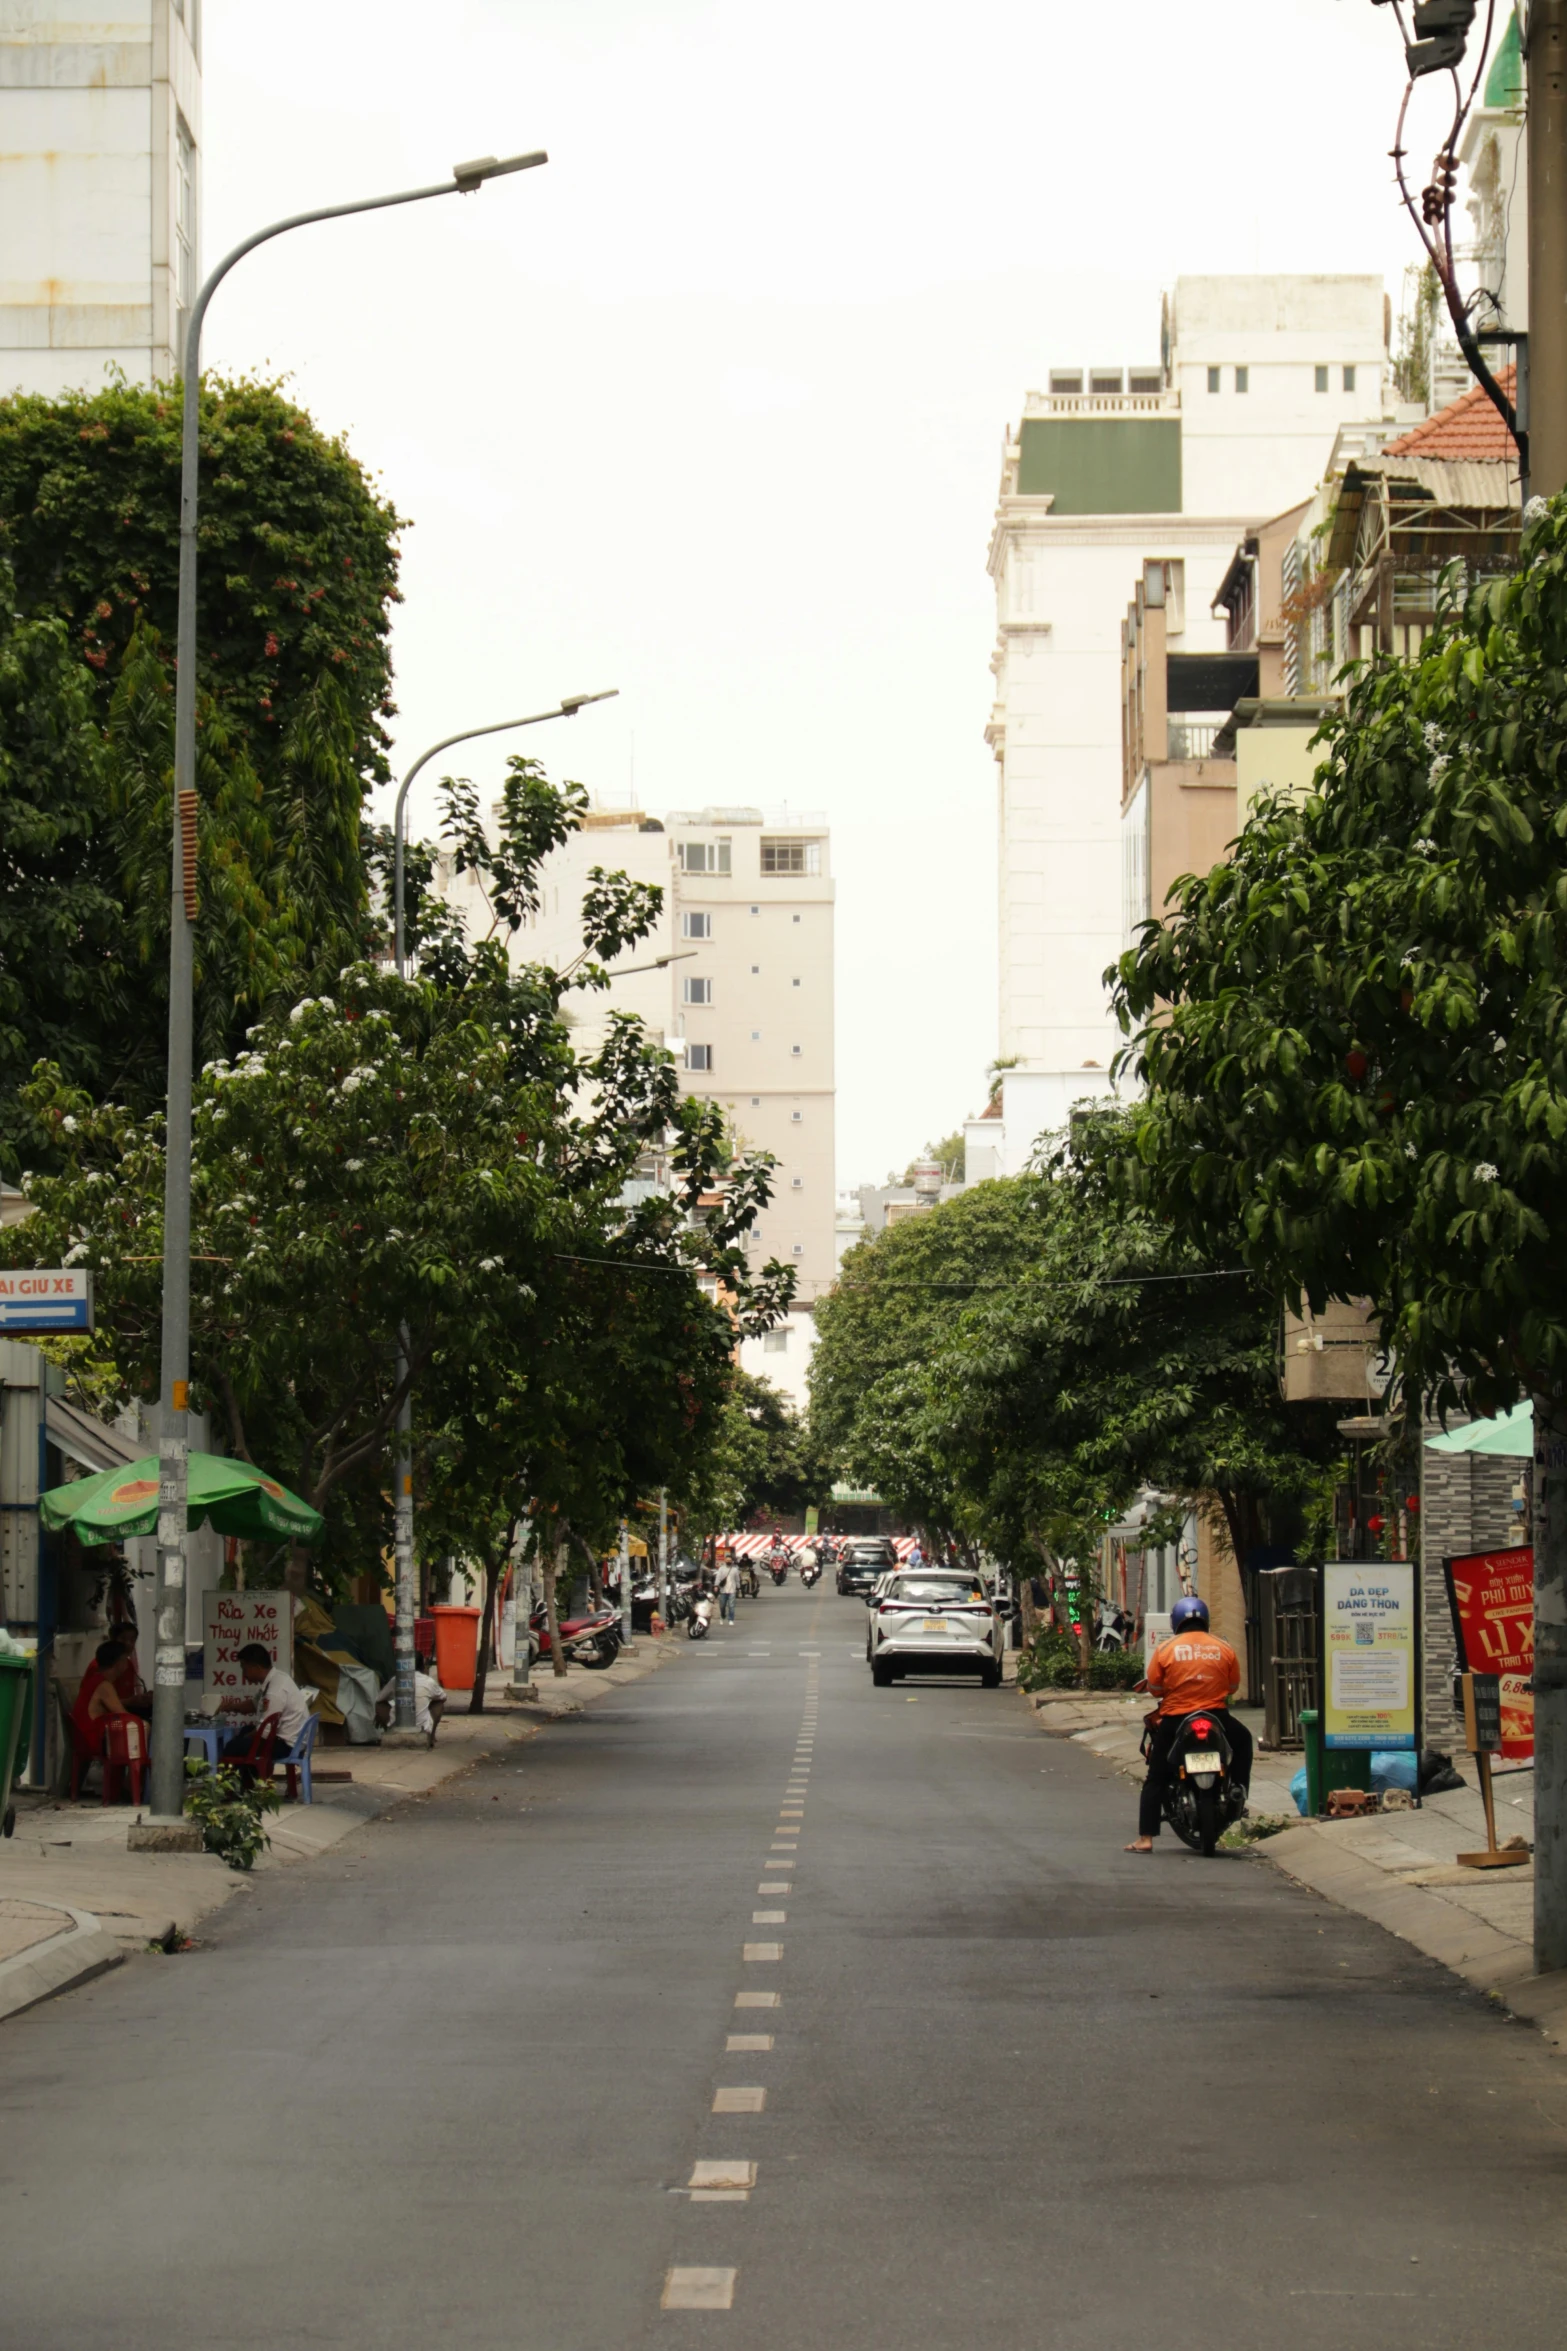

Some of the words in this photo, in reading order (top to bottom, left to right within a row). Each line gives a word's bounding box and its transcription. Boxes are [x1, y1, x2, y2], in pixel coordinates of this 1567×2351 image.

[52, 1278, 74, 1293] XE
[1496, 1555, 1528, 1567] SLENDER
[1505, 1573, 1525, 1585] XUÂN
[1350, 1587, 1365, 1596] DA
[1368, 1587, 1389, 1598] ĐẸP
[1480, 1585, 1507, 1606] PHÚ
[218, 1598, 245, 1620] Rửa
[253, 1604, 277, 1619] Xe
[1337, 1598, 1368, 1610] DÁNG
[1370, 1598, 1399, 1610] THON
[209, 1624, 241, 1647] Thay
[247, 1623, 279, 1641] Nhớt
[1478, 1619, 1510, 1658] LÌ
[216, 1647, 239, 1662] Xe
[1194, 1651, 1221, 1661] Food
[1497, 1655, 1521, 1669] TRAO
[212, 1670, 237, 1686] Xe
